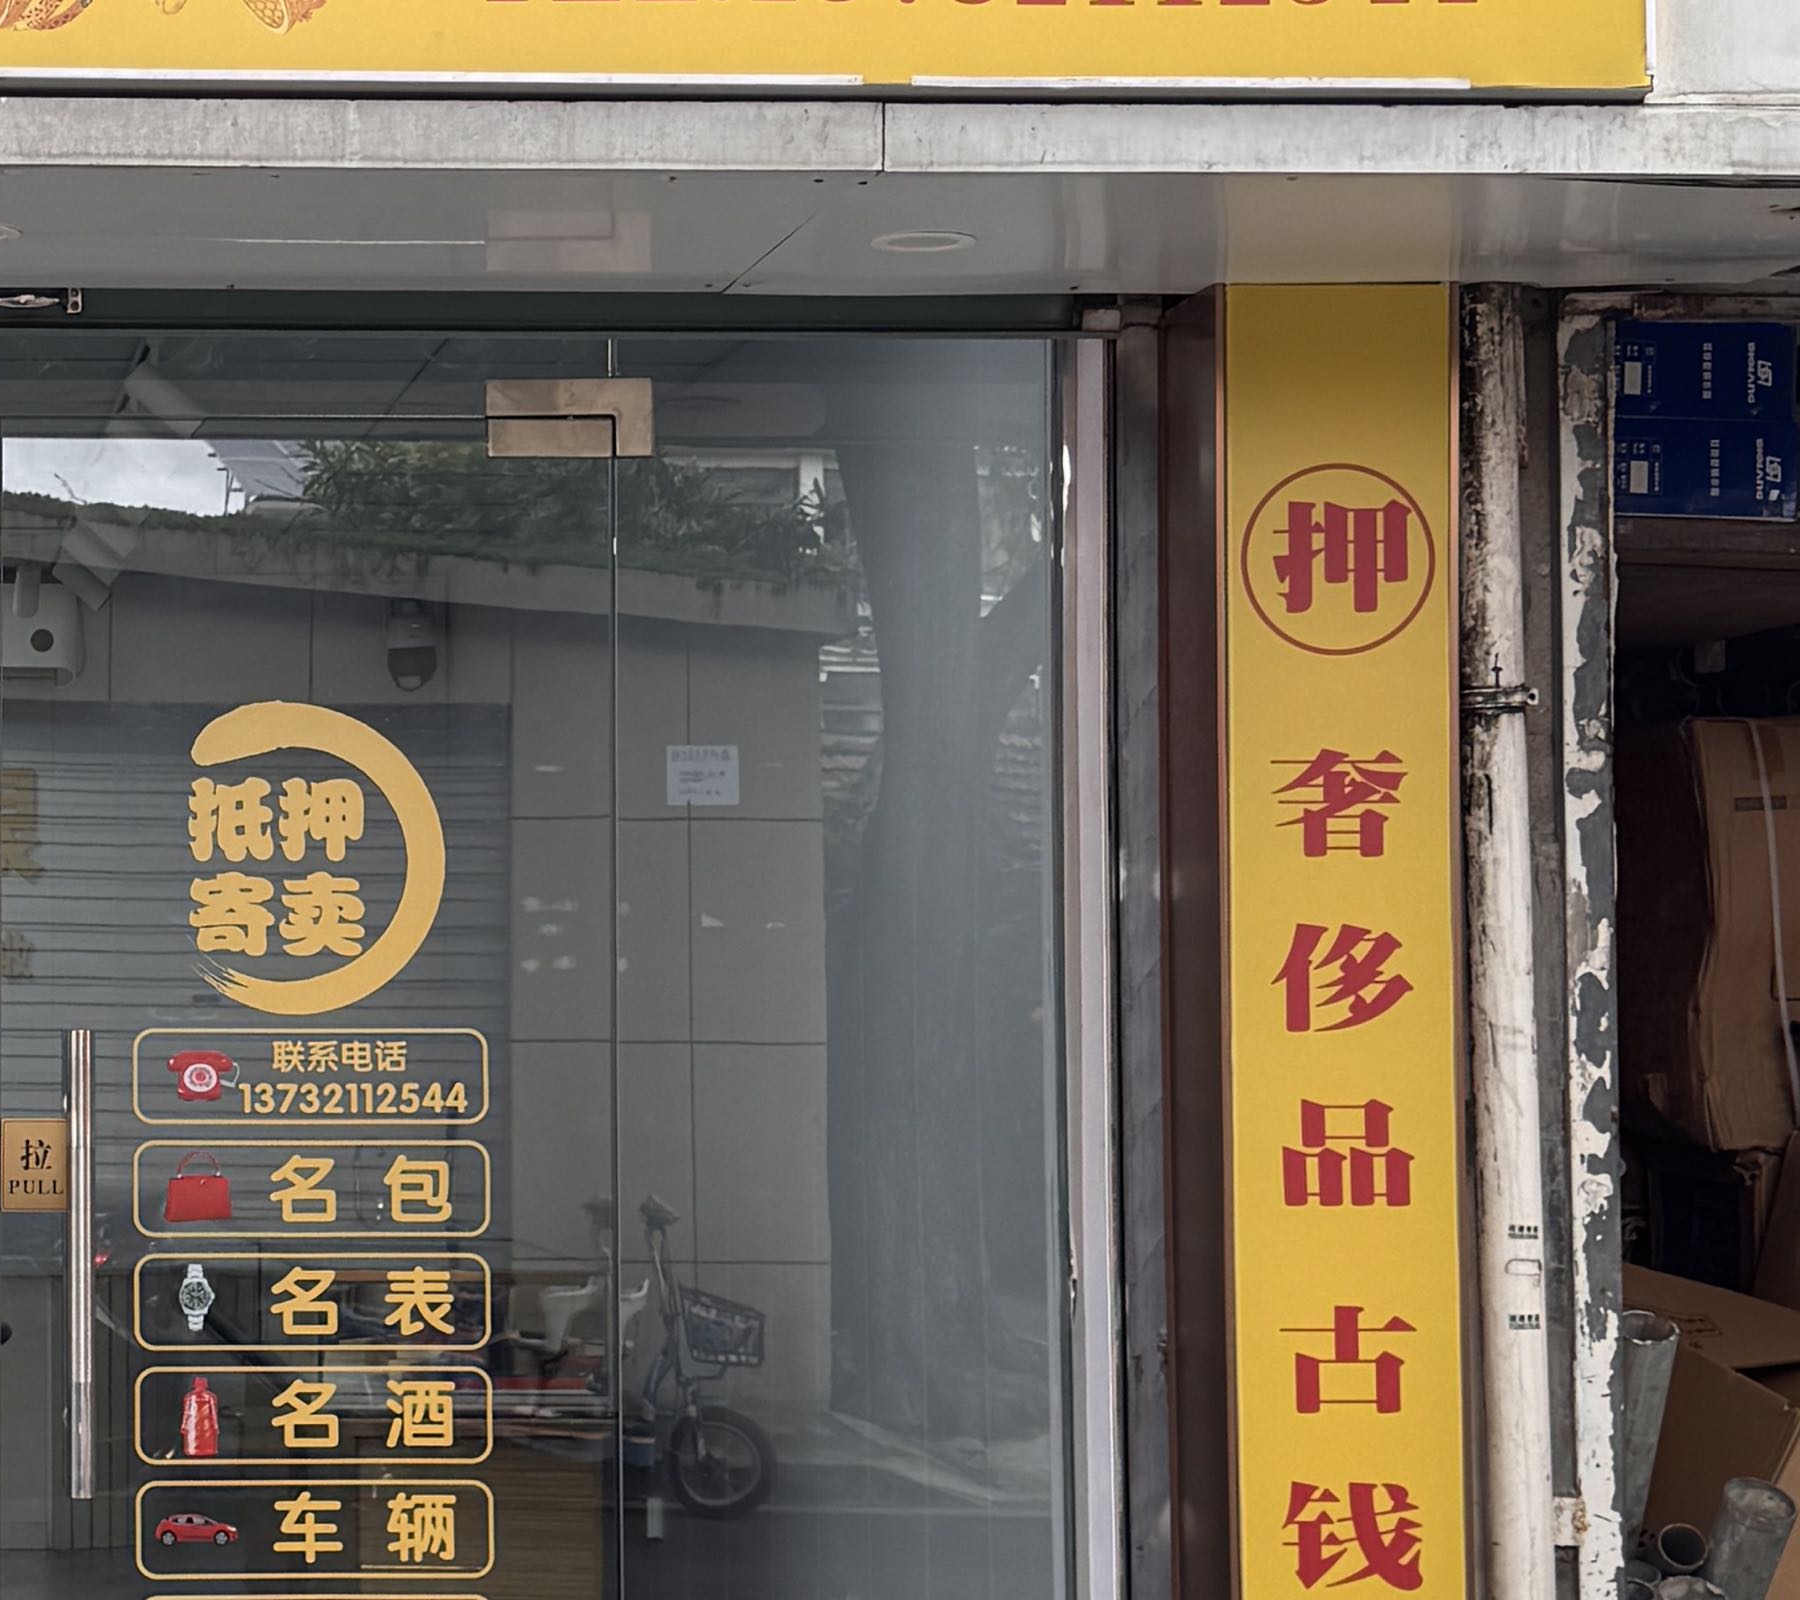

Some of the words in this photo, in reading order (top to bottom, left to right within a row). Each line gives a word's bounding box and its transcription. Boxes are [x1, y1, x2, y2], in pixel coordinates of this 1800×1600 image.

[1272, 499, 1413, 613] 押
[186, 777, 365, 863] 抵押
[188, 871, 366, 958] 寄卖
[270, 1039, 407, 1075] 联系电话
[239, 1082, 468, 1115] 13732112544
[8, 1178, 65, 1196] PULL
[20, 1138, 53, 1171] 拉
[269, 1155, 452, 1224] 名包
[269, 1266, 455, 1337] 名表
[271, 1379, 456, 1449] 名酒
[273, 1491, 458, 1565] 车辆
